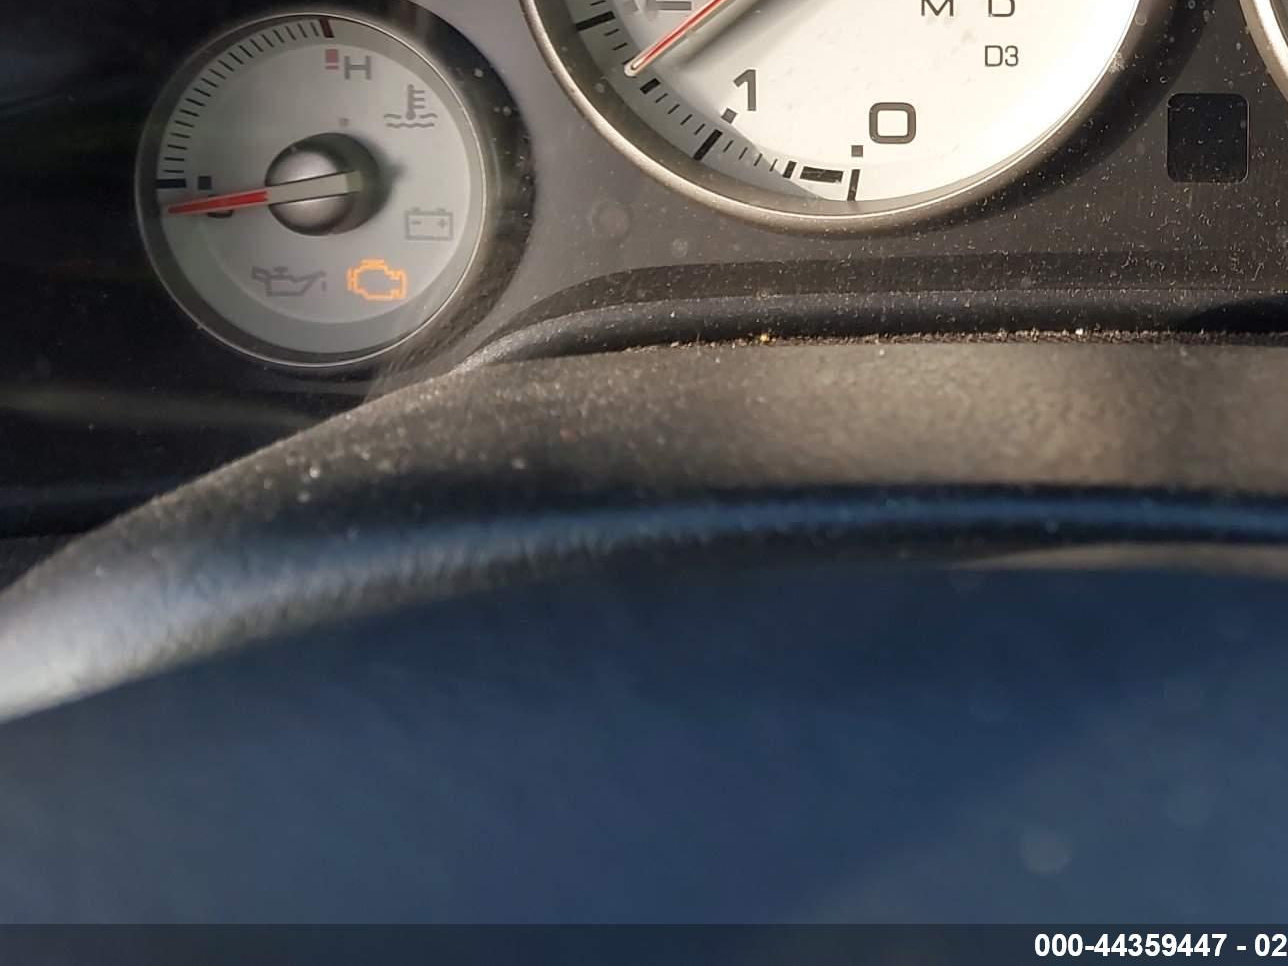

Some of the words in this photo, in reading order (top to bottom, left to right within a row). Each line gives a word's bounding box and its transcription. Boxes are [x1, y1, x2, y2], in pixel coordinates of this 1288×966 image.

[344, 55, 372, 80] H
[984, 45, 1020, 68] D3
[733, 69, 758, 112] 1
[869, 102, 917, 144] 0
